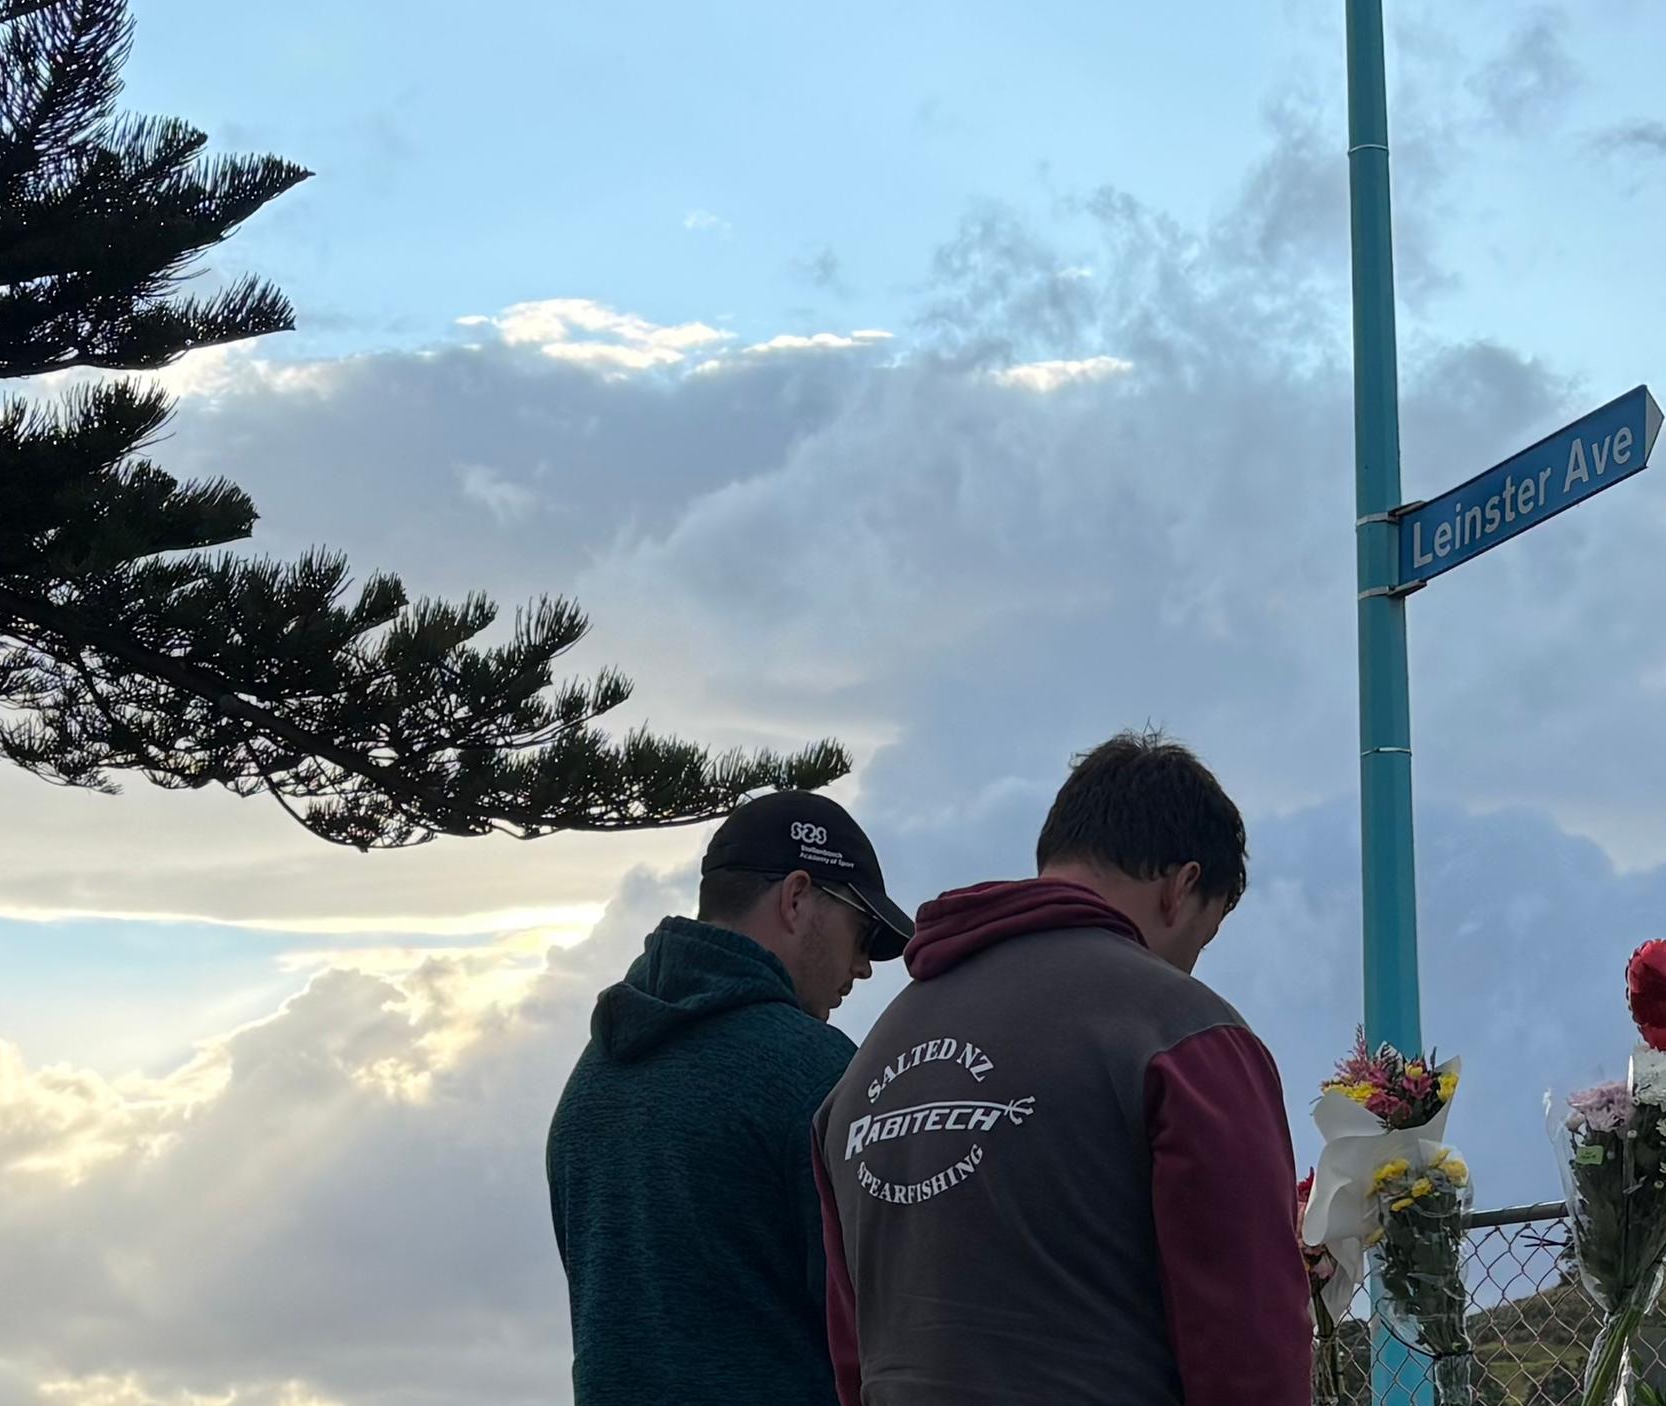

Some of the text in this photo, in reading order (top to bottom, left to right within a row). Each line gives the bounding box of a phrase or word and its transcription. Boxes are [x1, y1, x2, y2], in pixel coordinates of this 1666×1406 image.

[1413, 426, 1633, 569] Leinster Ave
[867, 1037, 994, 1104] SALTED NZ
[844, 1107, 1004, 1161] RABITECH
[856, 1143, 984, 1205] SPEARFISHING
